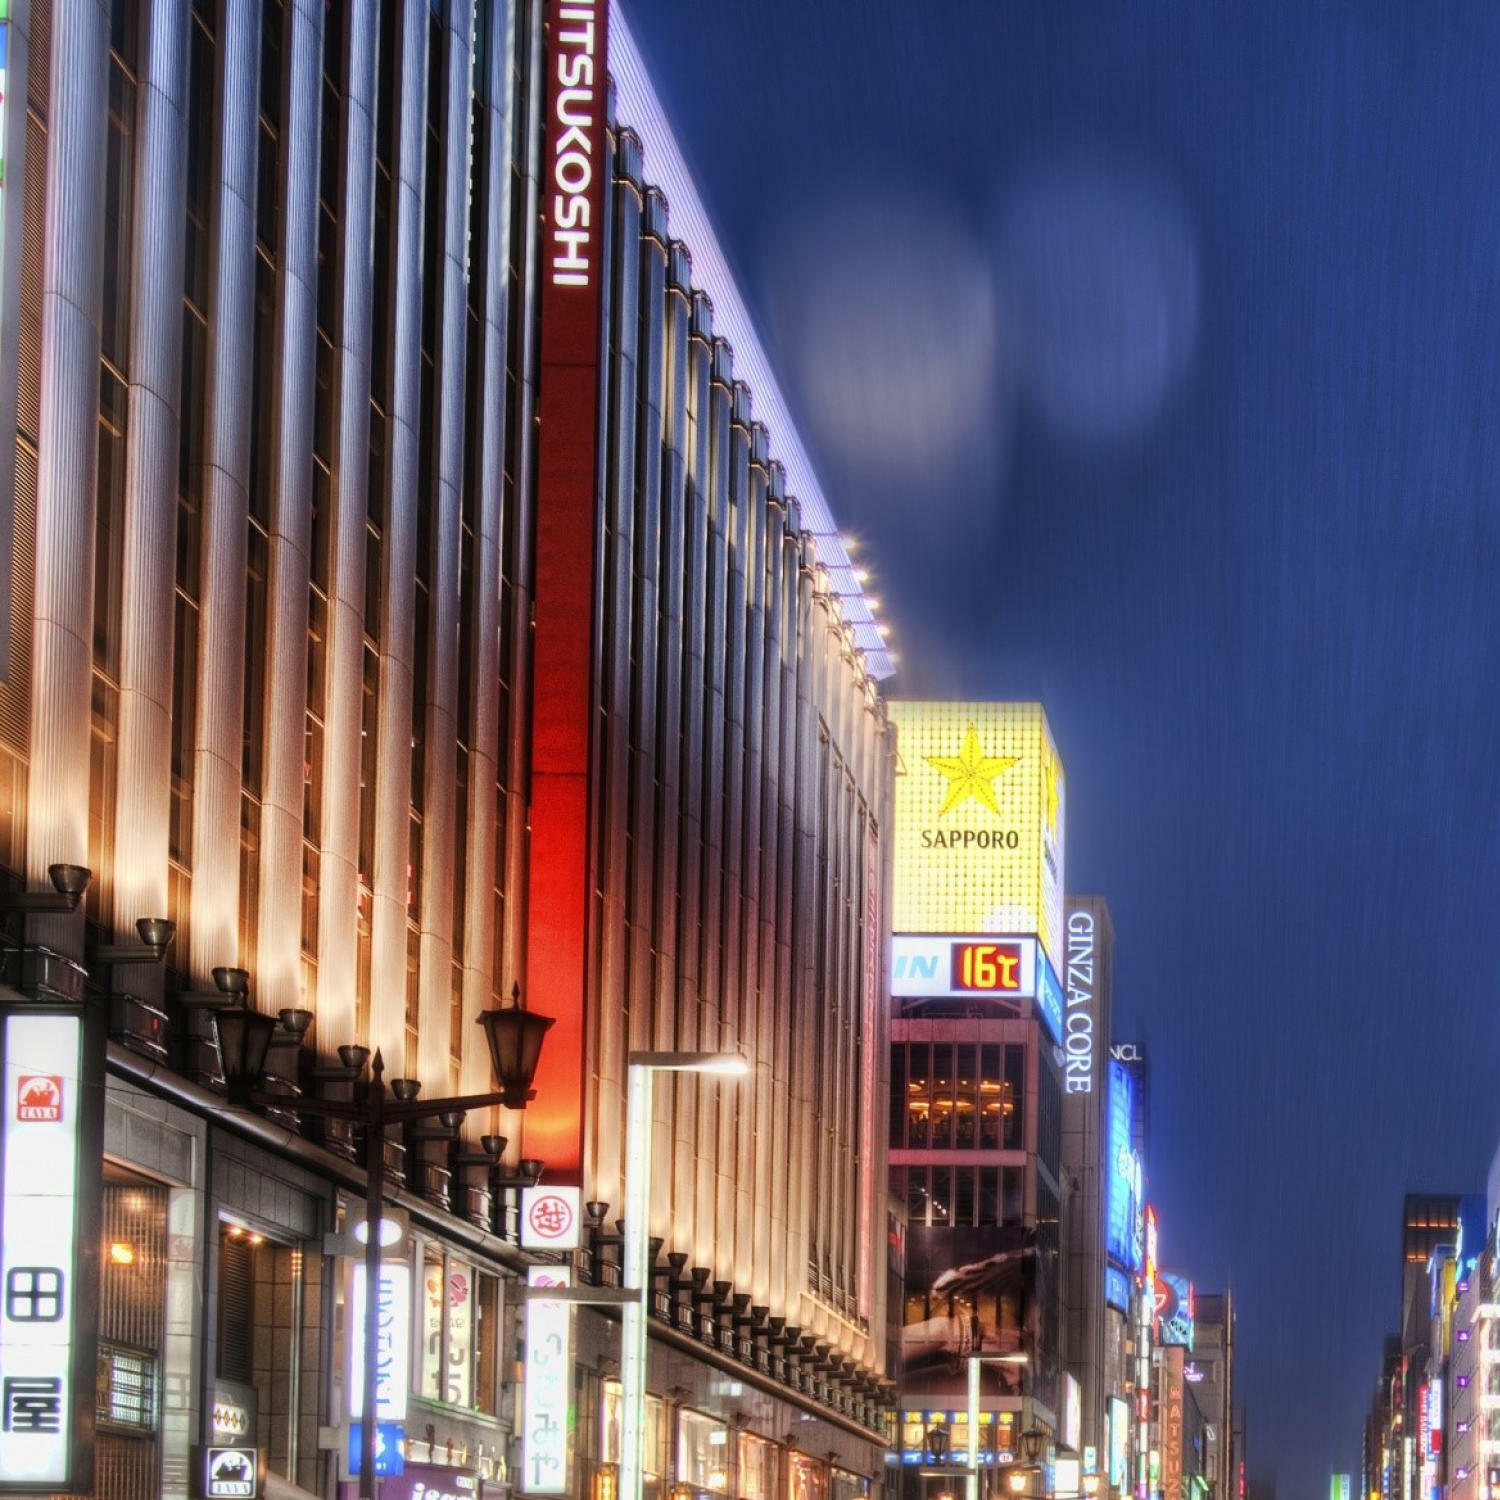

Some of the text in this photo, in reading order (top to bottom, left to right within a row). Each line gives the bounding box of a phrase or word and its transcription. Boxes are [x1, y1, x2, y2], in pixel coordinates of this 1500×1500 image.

[553, 0, 595, 286] ITSUKOSHI
[920, 829, 1020, 850] SAPPORO
[1066, 911, 1095, 1094] GINZA CORE
[3, 1266, 64, 1434] 田屋
